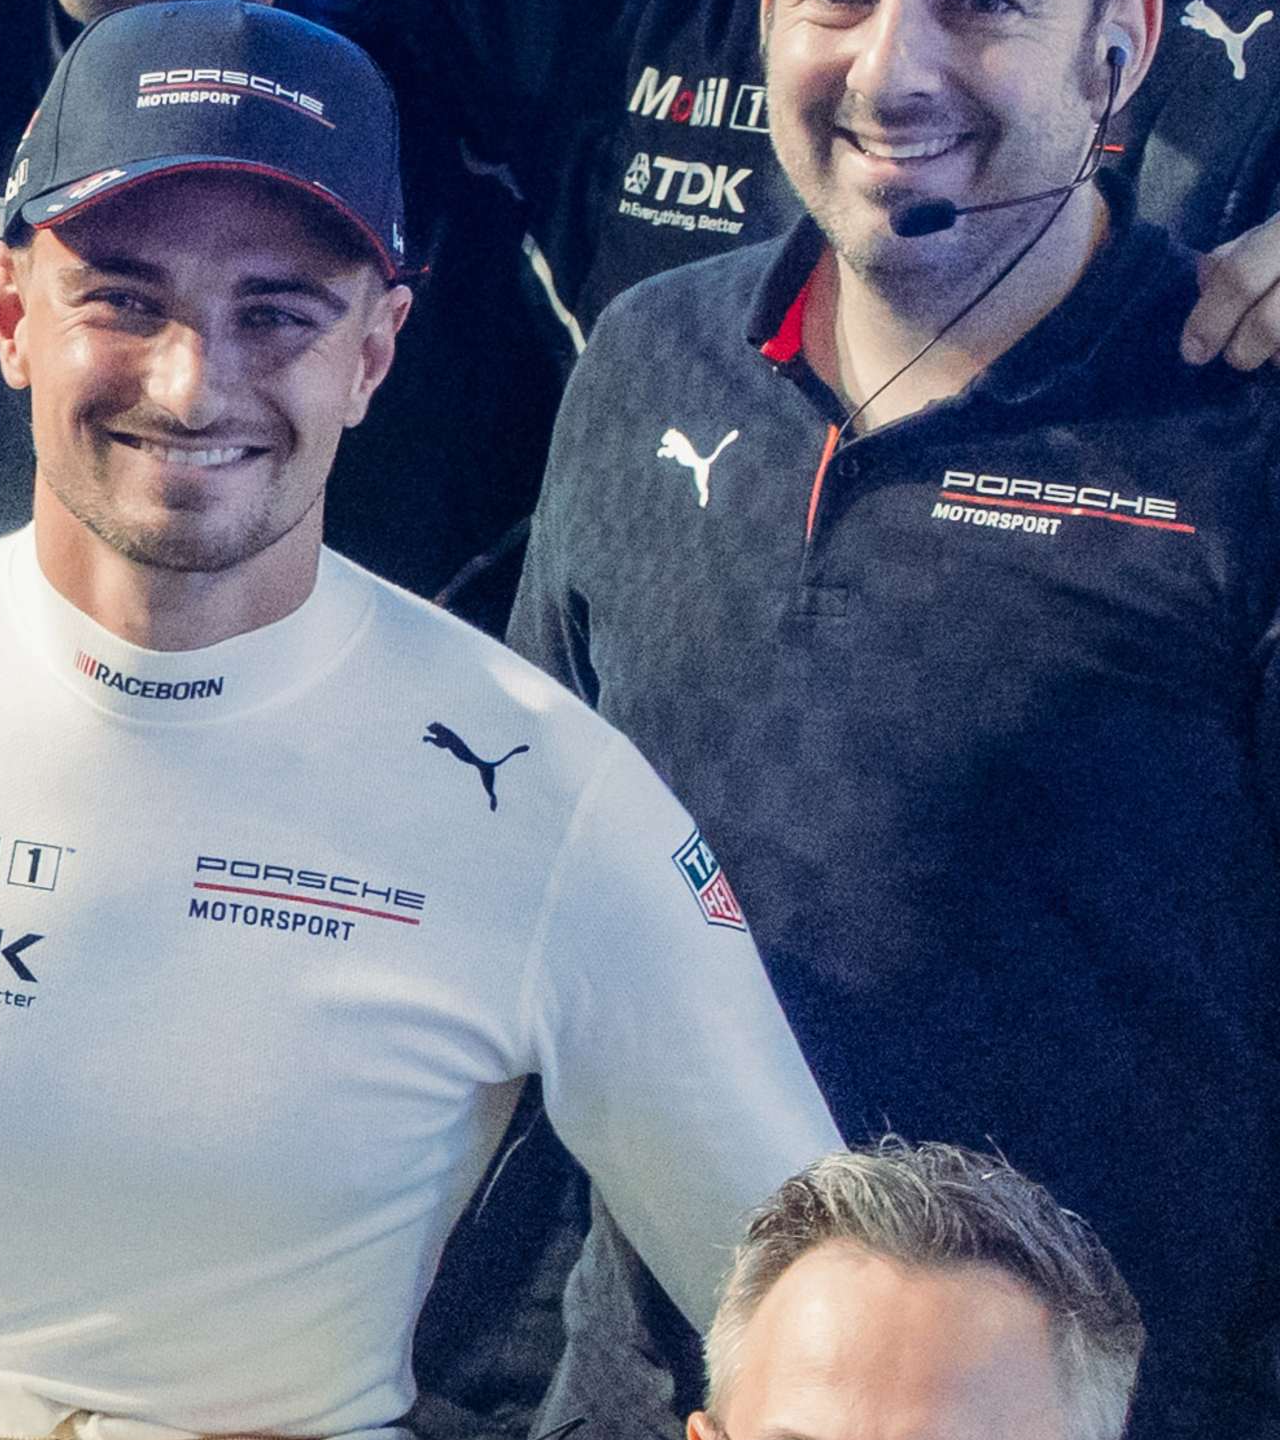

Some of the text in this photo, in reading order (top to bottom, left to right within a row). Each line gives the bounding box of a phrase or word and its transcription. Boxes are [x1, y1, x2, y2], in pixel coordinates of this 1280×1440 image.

[136, 91, 241, 108] MOTORSPORT
[139, 69, 324, 115] PORSCHE
[653, 156, 753, 214] TDK
[697, 215, 744, 235] Better
[942, 470, 1177, 520] PORSCHE
[931, 502, 1062, 536] MOTORSPORT
[94, 662, 225, 701] RACEBORN
[196, 855, 427, 911] PORSCHE
[188, 898, 356, 942] MOTORSPORT
